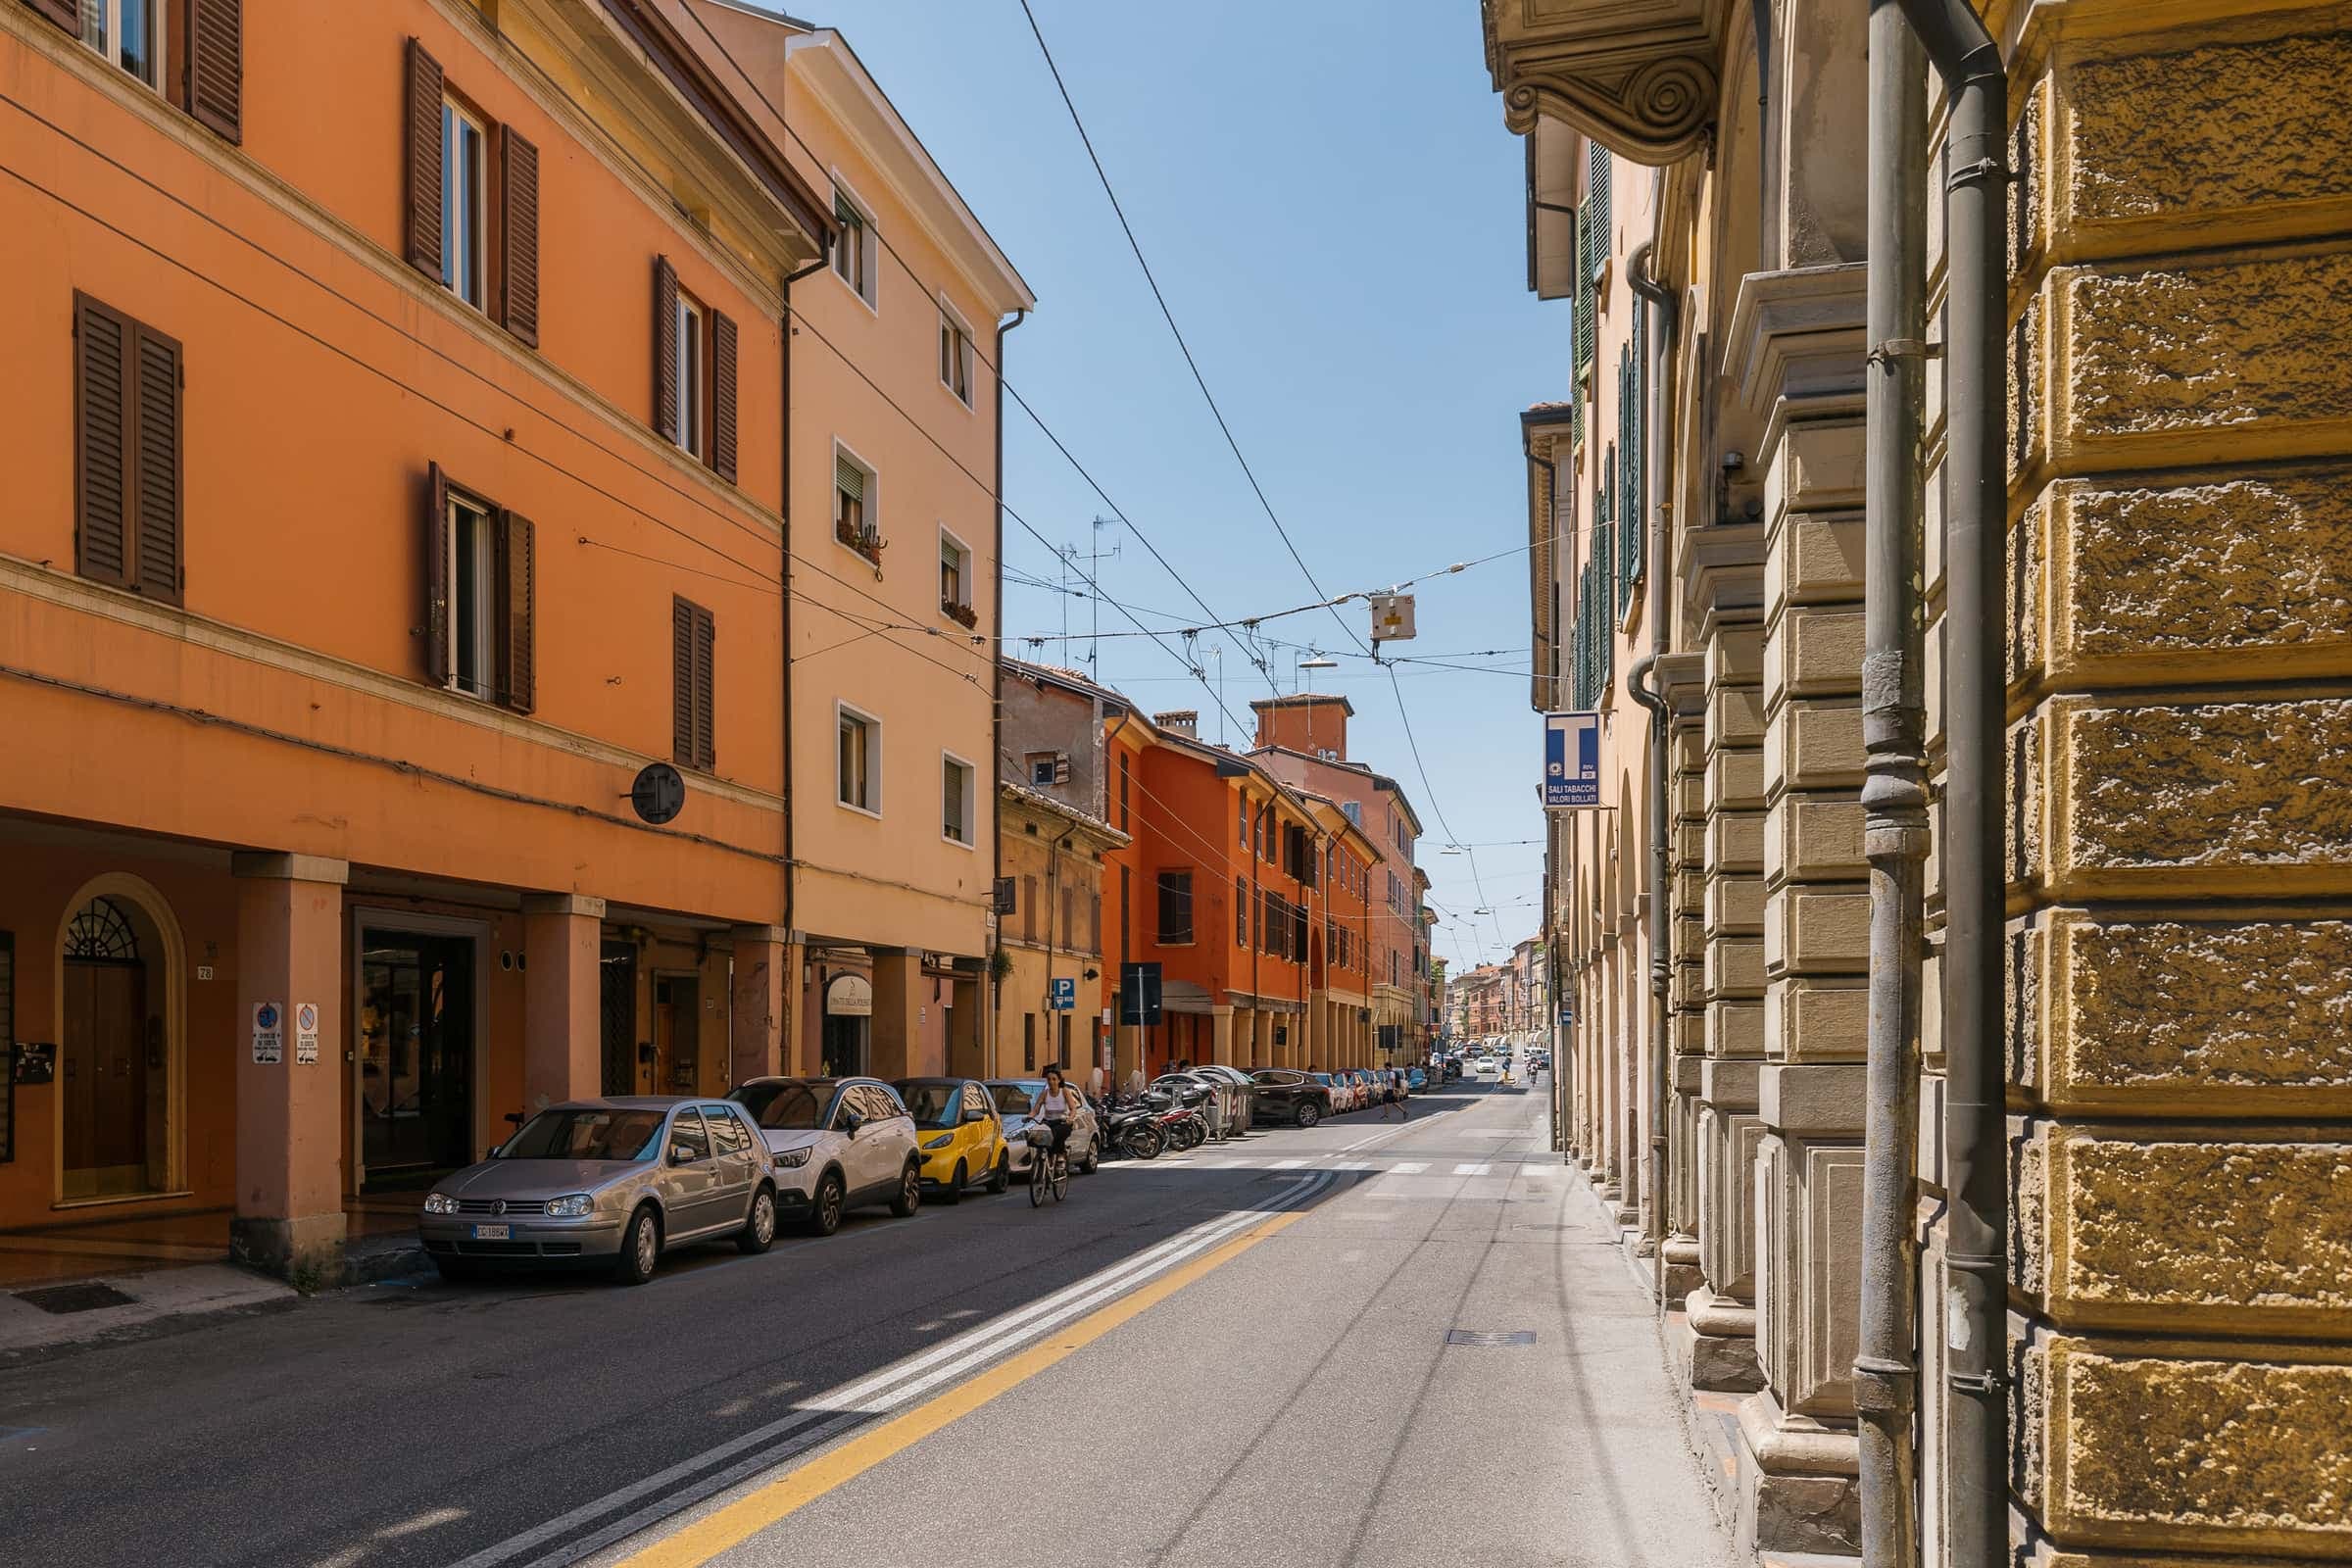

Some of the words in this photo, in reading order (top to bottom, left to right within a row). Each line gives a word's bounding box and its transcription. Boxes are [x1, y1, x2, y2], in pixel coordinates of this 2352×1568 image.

[1548, 716, 1595, 779] T
[1548, 785, 1563, 794] SALI
[1564, 784, 1596, 793] TABACCHI
[1548, 795, 1570, 804] VALORI
[199, 967, 212, 979] 78
[1059, 980, 1071, 995] P
